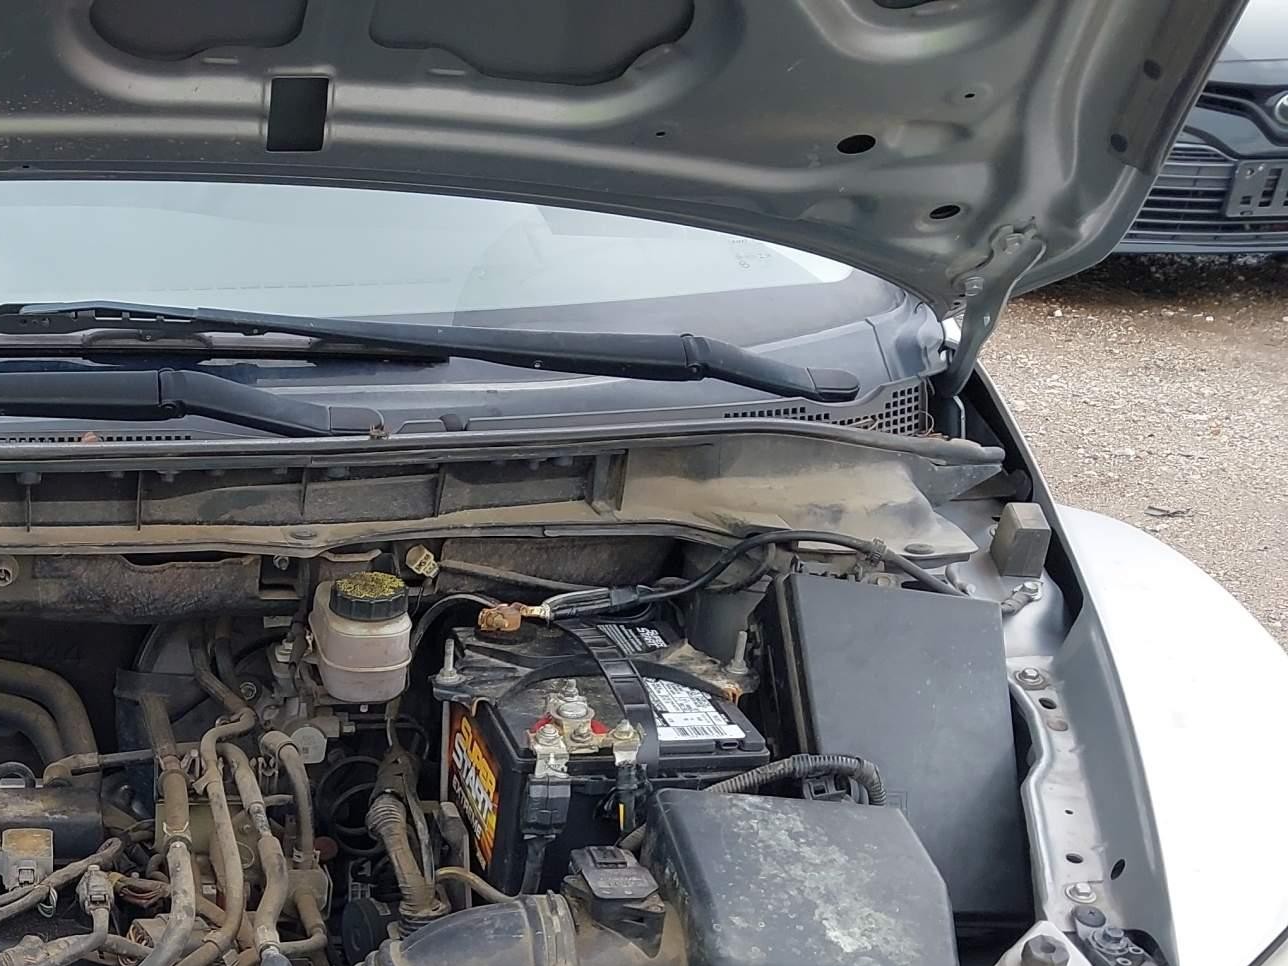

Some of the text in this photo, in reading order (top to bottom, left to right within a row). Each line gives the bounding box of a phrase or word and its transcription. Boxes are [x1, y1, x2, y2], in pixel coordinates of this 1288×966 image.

[452, 732, 493, 821] START
[461, 716, 496, 801] SUPER
[452, 773, 482, 840] EXTREME
